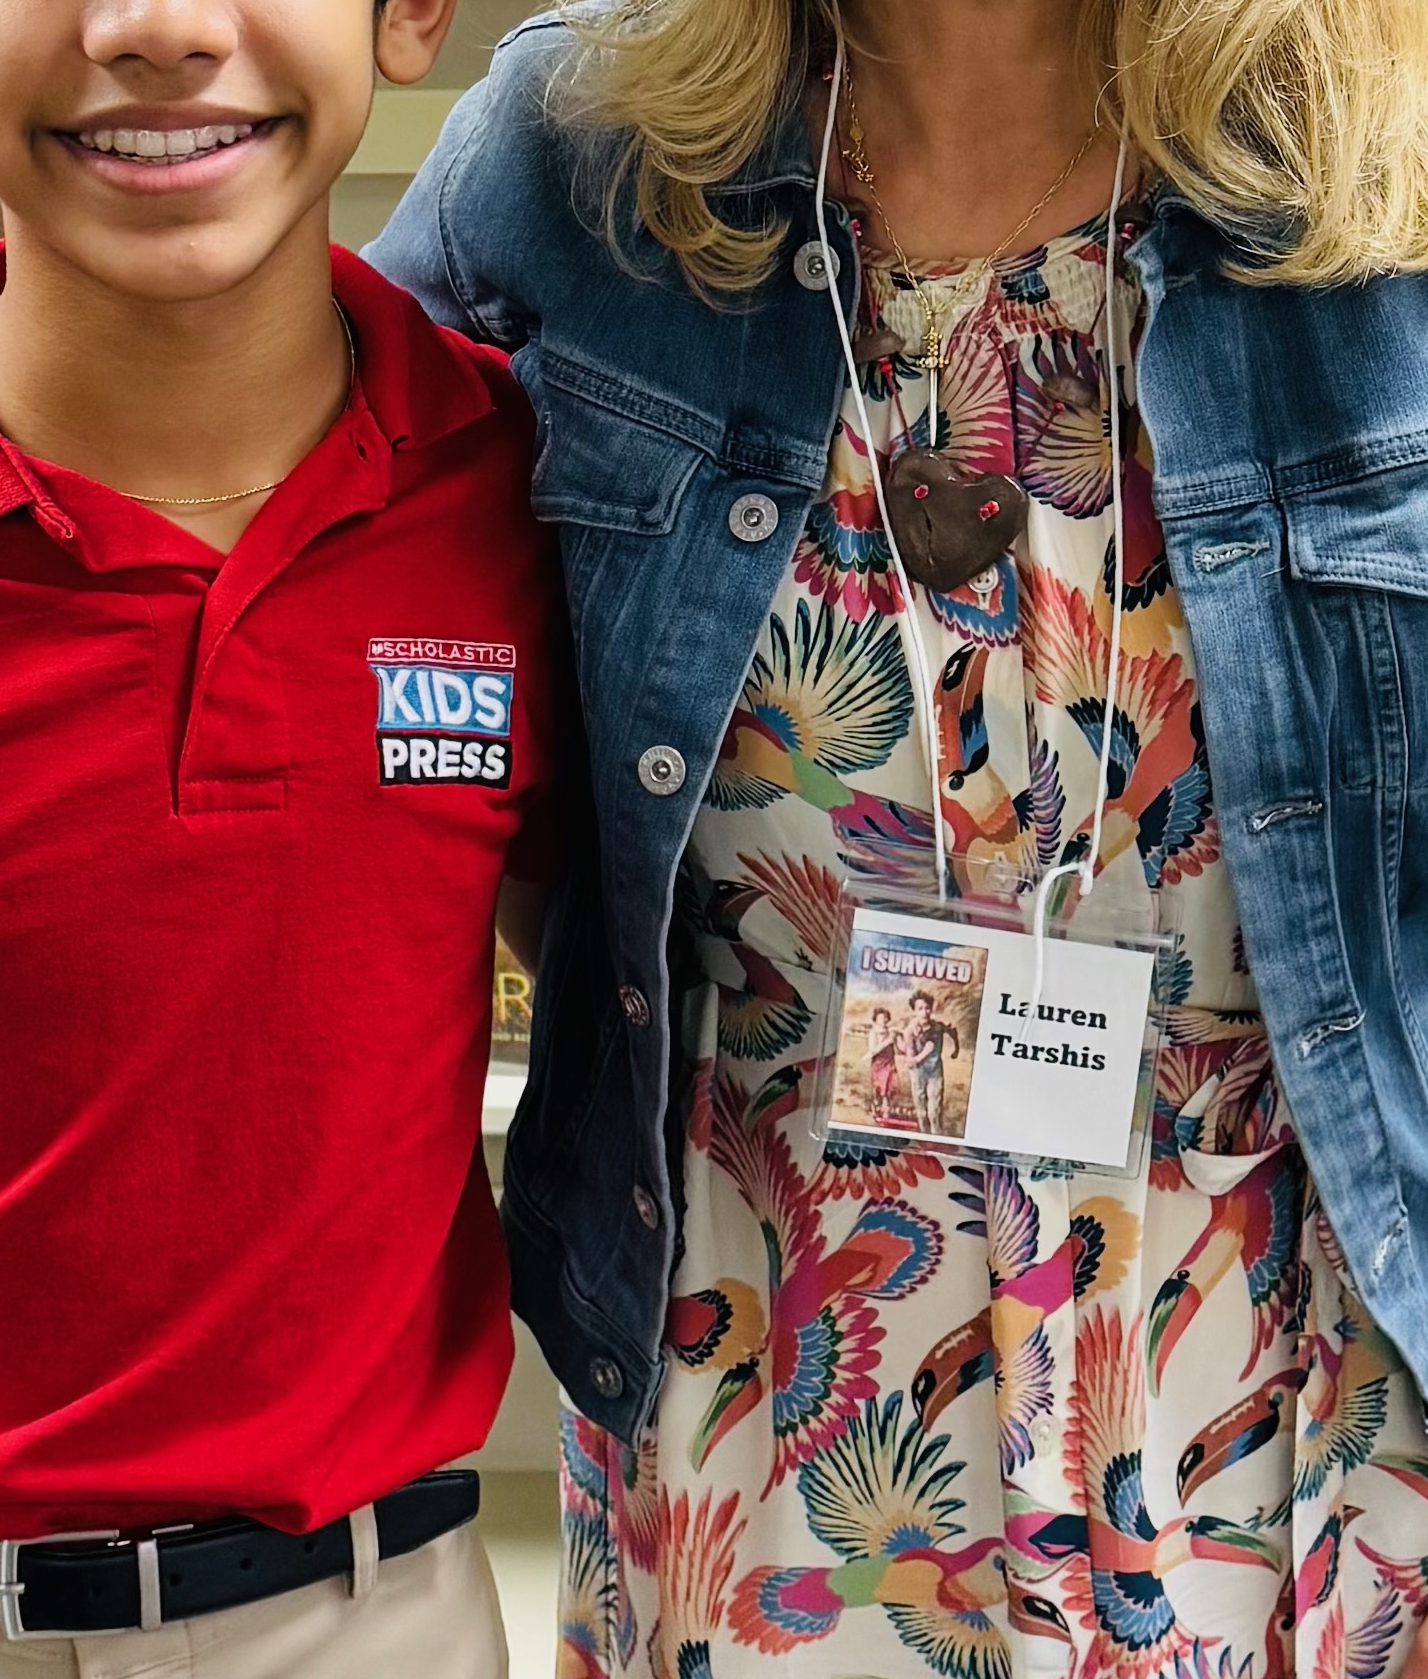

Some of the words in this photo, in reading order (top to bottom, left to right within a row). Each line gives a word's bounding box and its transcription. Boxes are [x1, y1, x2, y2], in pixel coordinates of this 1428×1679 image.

[383, 642, 512, 663] SCHOLASTIC
[377, 668, 507, 729] KIDS
[382, 738, 506, 780] PRESS
[862, 946, 870, 969] I
[873, 948, 973, 984] SURVIVED
[998, 993, 1108, 1030] Lauren
[991, 1033, 1106, 1071] Tarshis
